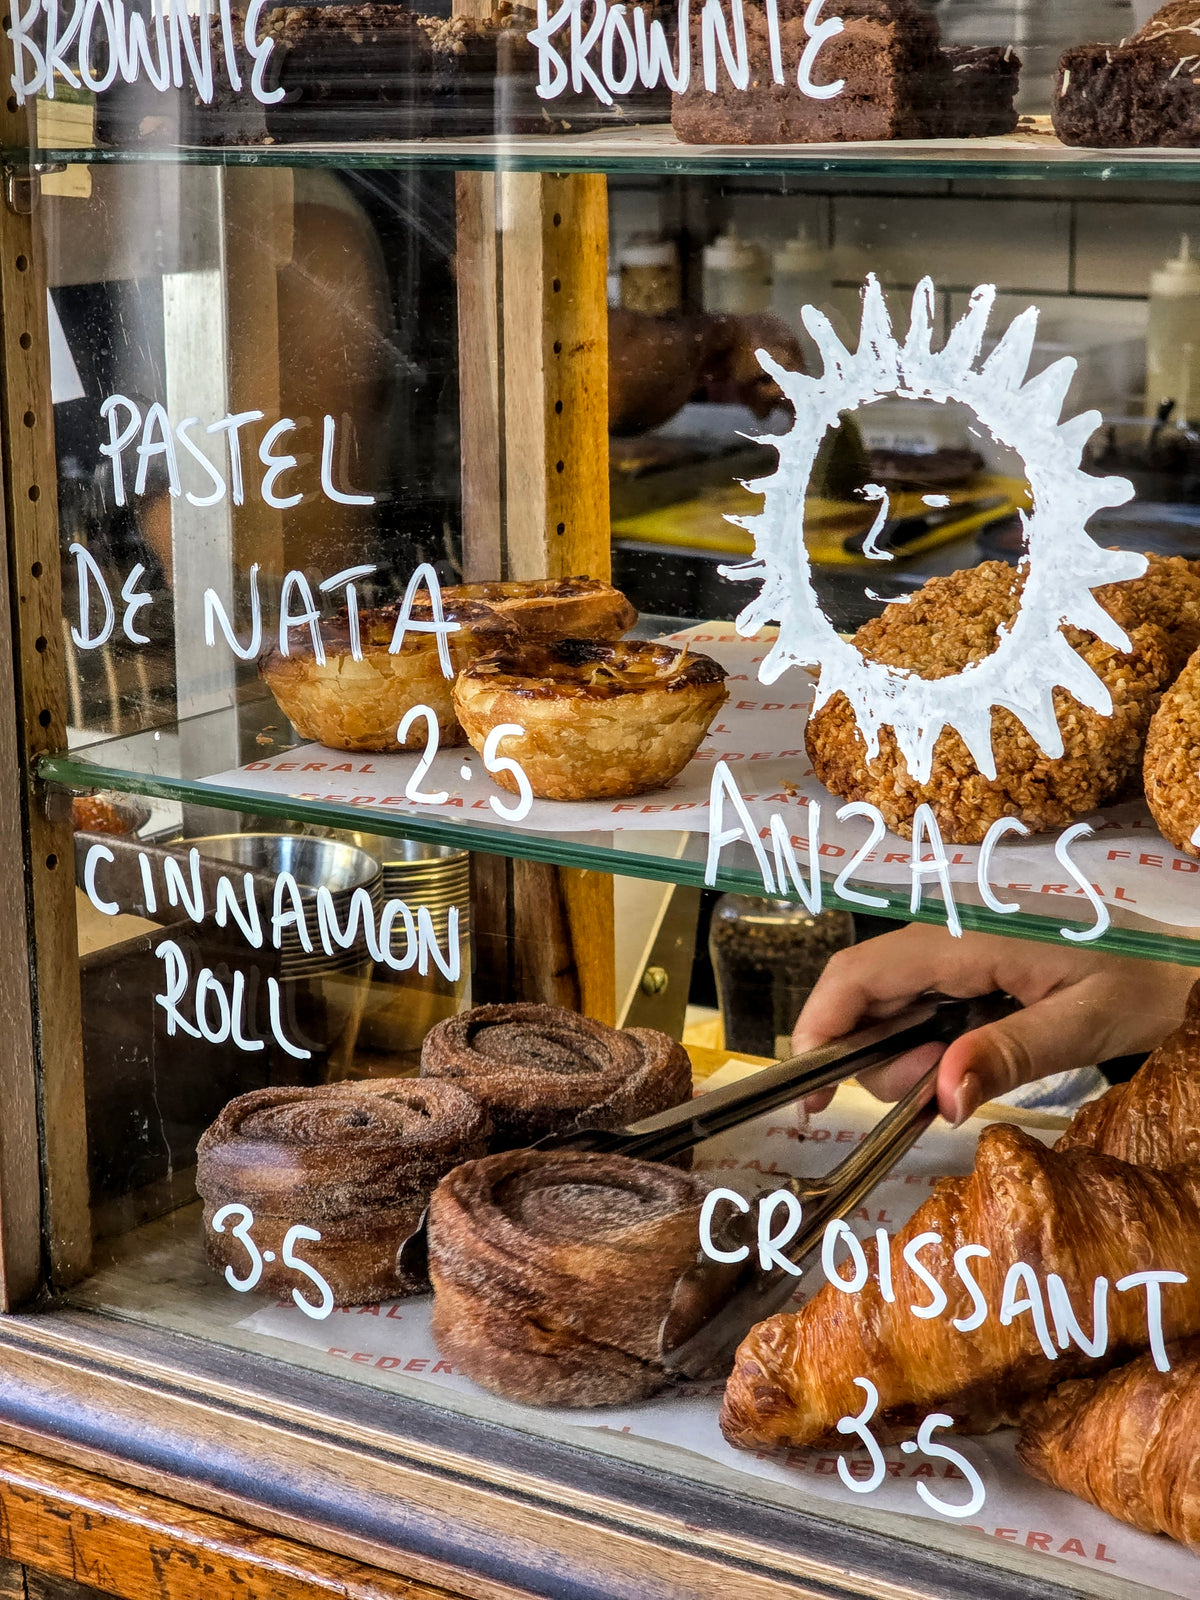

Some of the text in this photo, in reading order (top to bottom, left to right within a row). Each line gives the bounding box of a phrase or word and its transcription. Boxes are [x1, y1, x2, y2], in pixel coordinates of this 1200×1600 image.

[7, 0, 286, 105] BROWNIE
[526, 0, 845, 106] BROWNIE
[99, 393, 377, 509] PASTEL
[69, 542, 463, 680] DE NATA
[83, 843, 461, 982] CINNAMON
[154, 939, 312, 1059] ROLL
[699, 1188, 1188, 1373] CROISSANT
